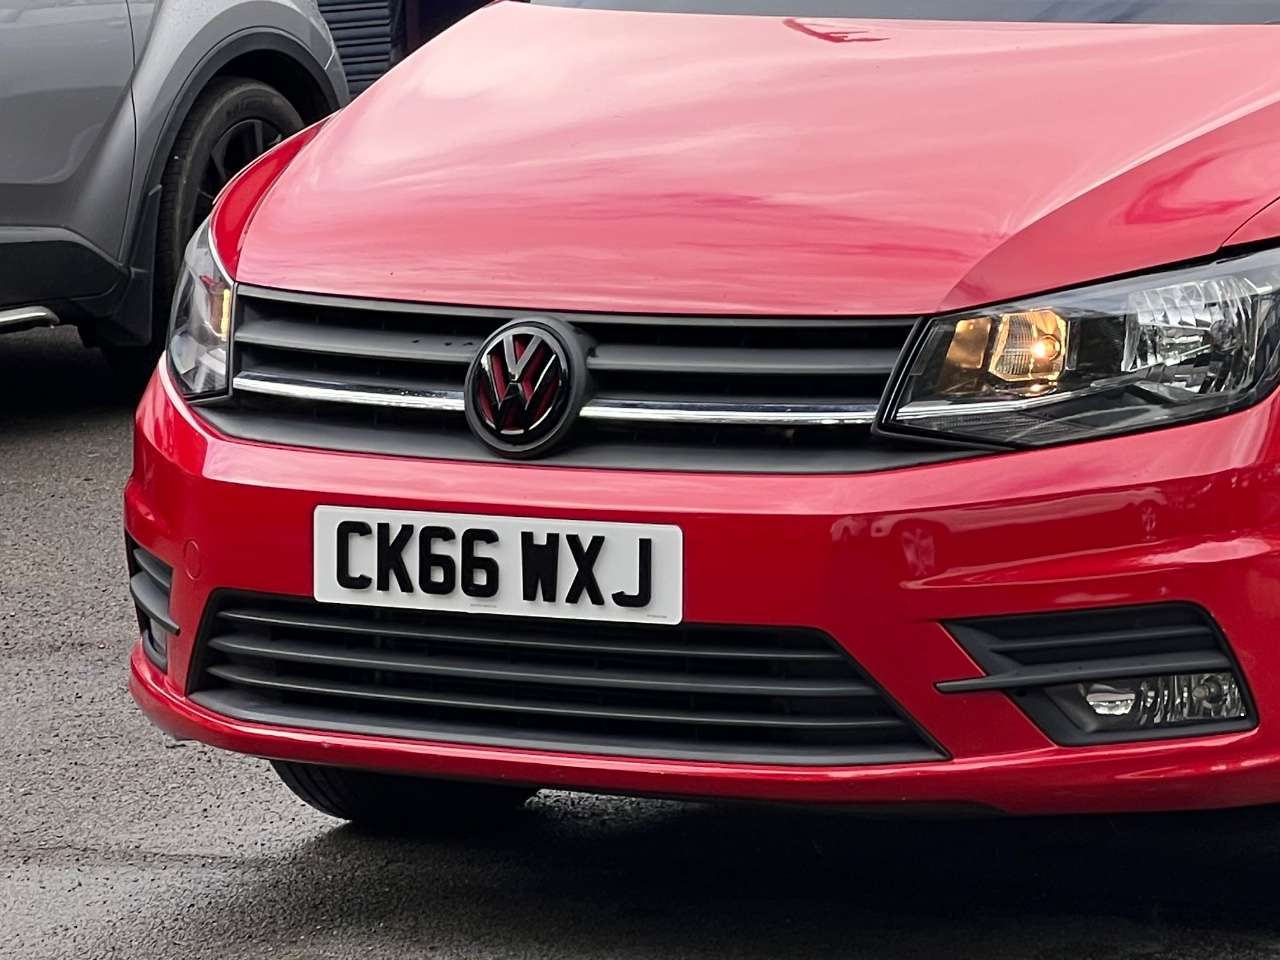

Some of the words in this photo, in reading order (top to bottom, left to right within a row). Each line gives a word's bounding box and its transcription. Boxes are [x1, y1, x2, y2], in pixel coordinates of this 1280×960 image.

[482, 330, 561, 436] VW
[336, 520, 499, 599] CK66
[520, 530, 652, 608] WXJ
